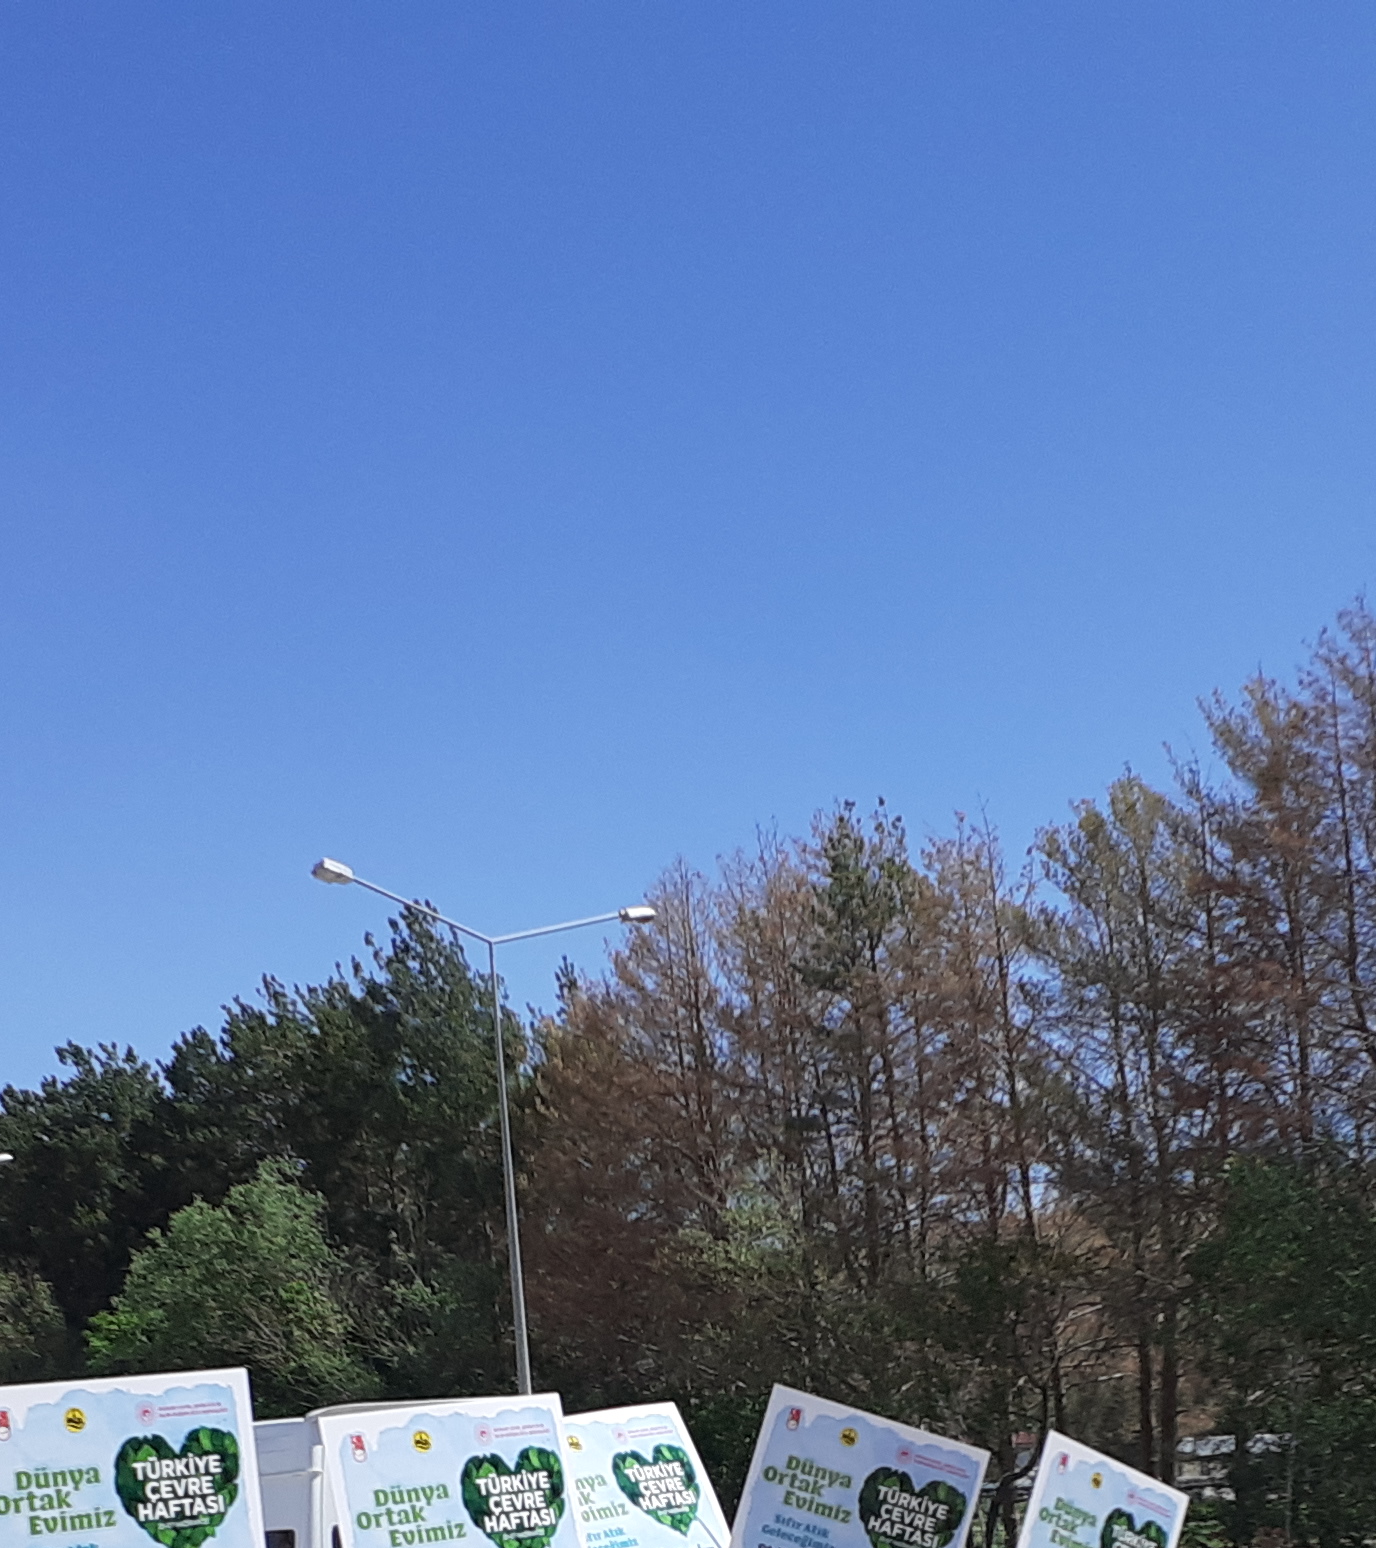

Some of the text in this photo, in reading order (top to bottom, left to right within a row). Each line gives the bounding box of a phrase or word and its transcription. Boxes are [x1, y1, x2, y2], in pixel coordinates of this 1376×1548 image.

[15, 1466, 101, 1491] Dünya
[132, 1452, 223, 1481] TÜRKİYE
[625, 1461, 685, 1483] TÜRKİYE
[786, 1455, 853, 1489] Dünya
[145, 1476, 215, 1503] ÇEVRE
[475, 1470, 550, 1496] TÜRKİYE
[575, 1473, 608, 1493] nya
[639, 1477, 686, 1498] ÇEVRE
[763, 1465, 824, 1497] Ortak
[137, 1495, 226, 1522] HAFTASI
[373, 1483, 449, 1507] Dünya
[489, 1490, 546, 1515] ÇEVRE
[638, 1490, 696, 1511] HAFTASI
[783, 1490, 852, 1524] Evimiz
[877, 1485, 950, 1520] TÜRKİYE
[29, 1507, 116, 1535] Evimiz
[356, 1504, 427, 1530] Ortak
[483, 1507, 557, 1534] HAFTASI
[879, 1504, 937, 1532] ÇEVRE
[389, 1520, 467, 1548] Evimiz
